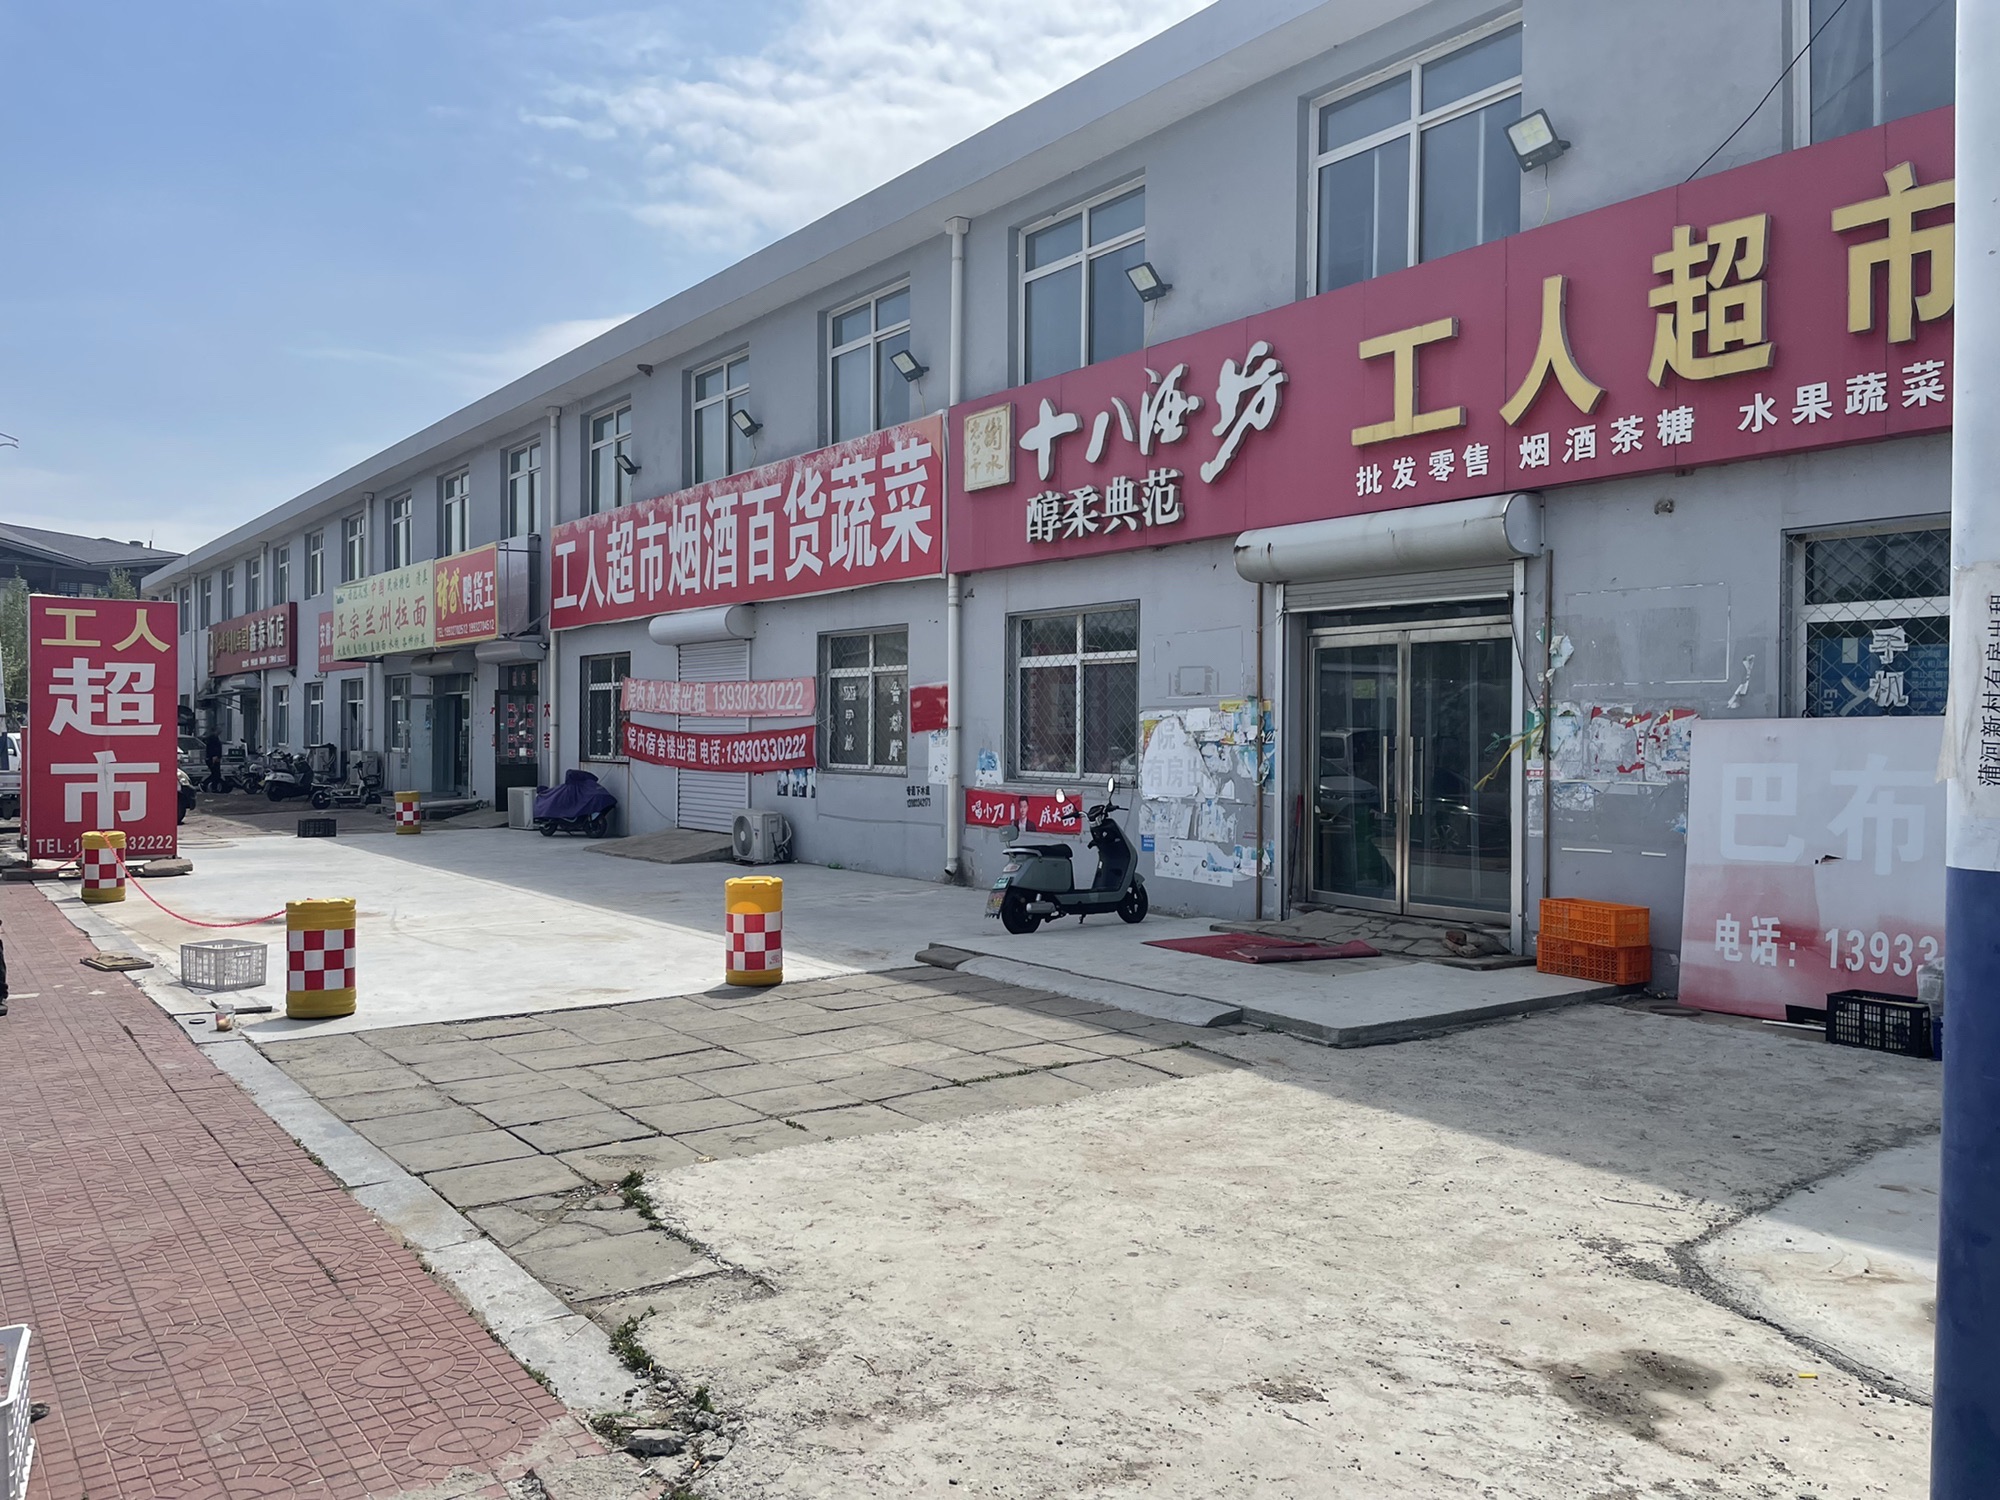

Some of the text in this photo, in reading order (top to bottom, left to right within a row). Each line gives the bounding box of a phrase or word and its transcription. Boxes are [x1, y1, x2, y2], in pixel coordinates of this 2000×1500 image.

[1351, 160, 1953, 447] 工人超市
[1019, 340, 1289, 484] 十八酒坊
[1356, 359, 1946, 497] 批发零售 烟酒茶糖 水果蔬菜
[553, 437, 933, 611] 工人超市烟酒百货蔬菜
[1026, 468, 1184, 543] 醇柔典范
[41, 607, 171, 652] 工人
[320, 622, 334, 648] 安徽
[337, 595, 427, 640] 正宗兰州拉面
[626, 681, 804, 713] 院内办公楼出租 13930330222
[48, 658, 162, 830] 超市
[626, 726, 697, 762] 院内宿舍楼出租
[971, 799, 1076, 827] 喝小刀 成大器
